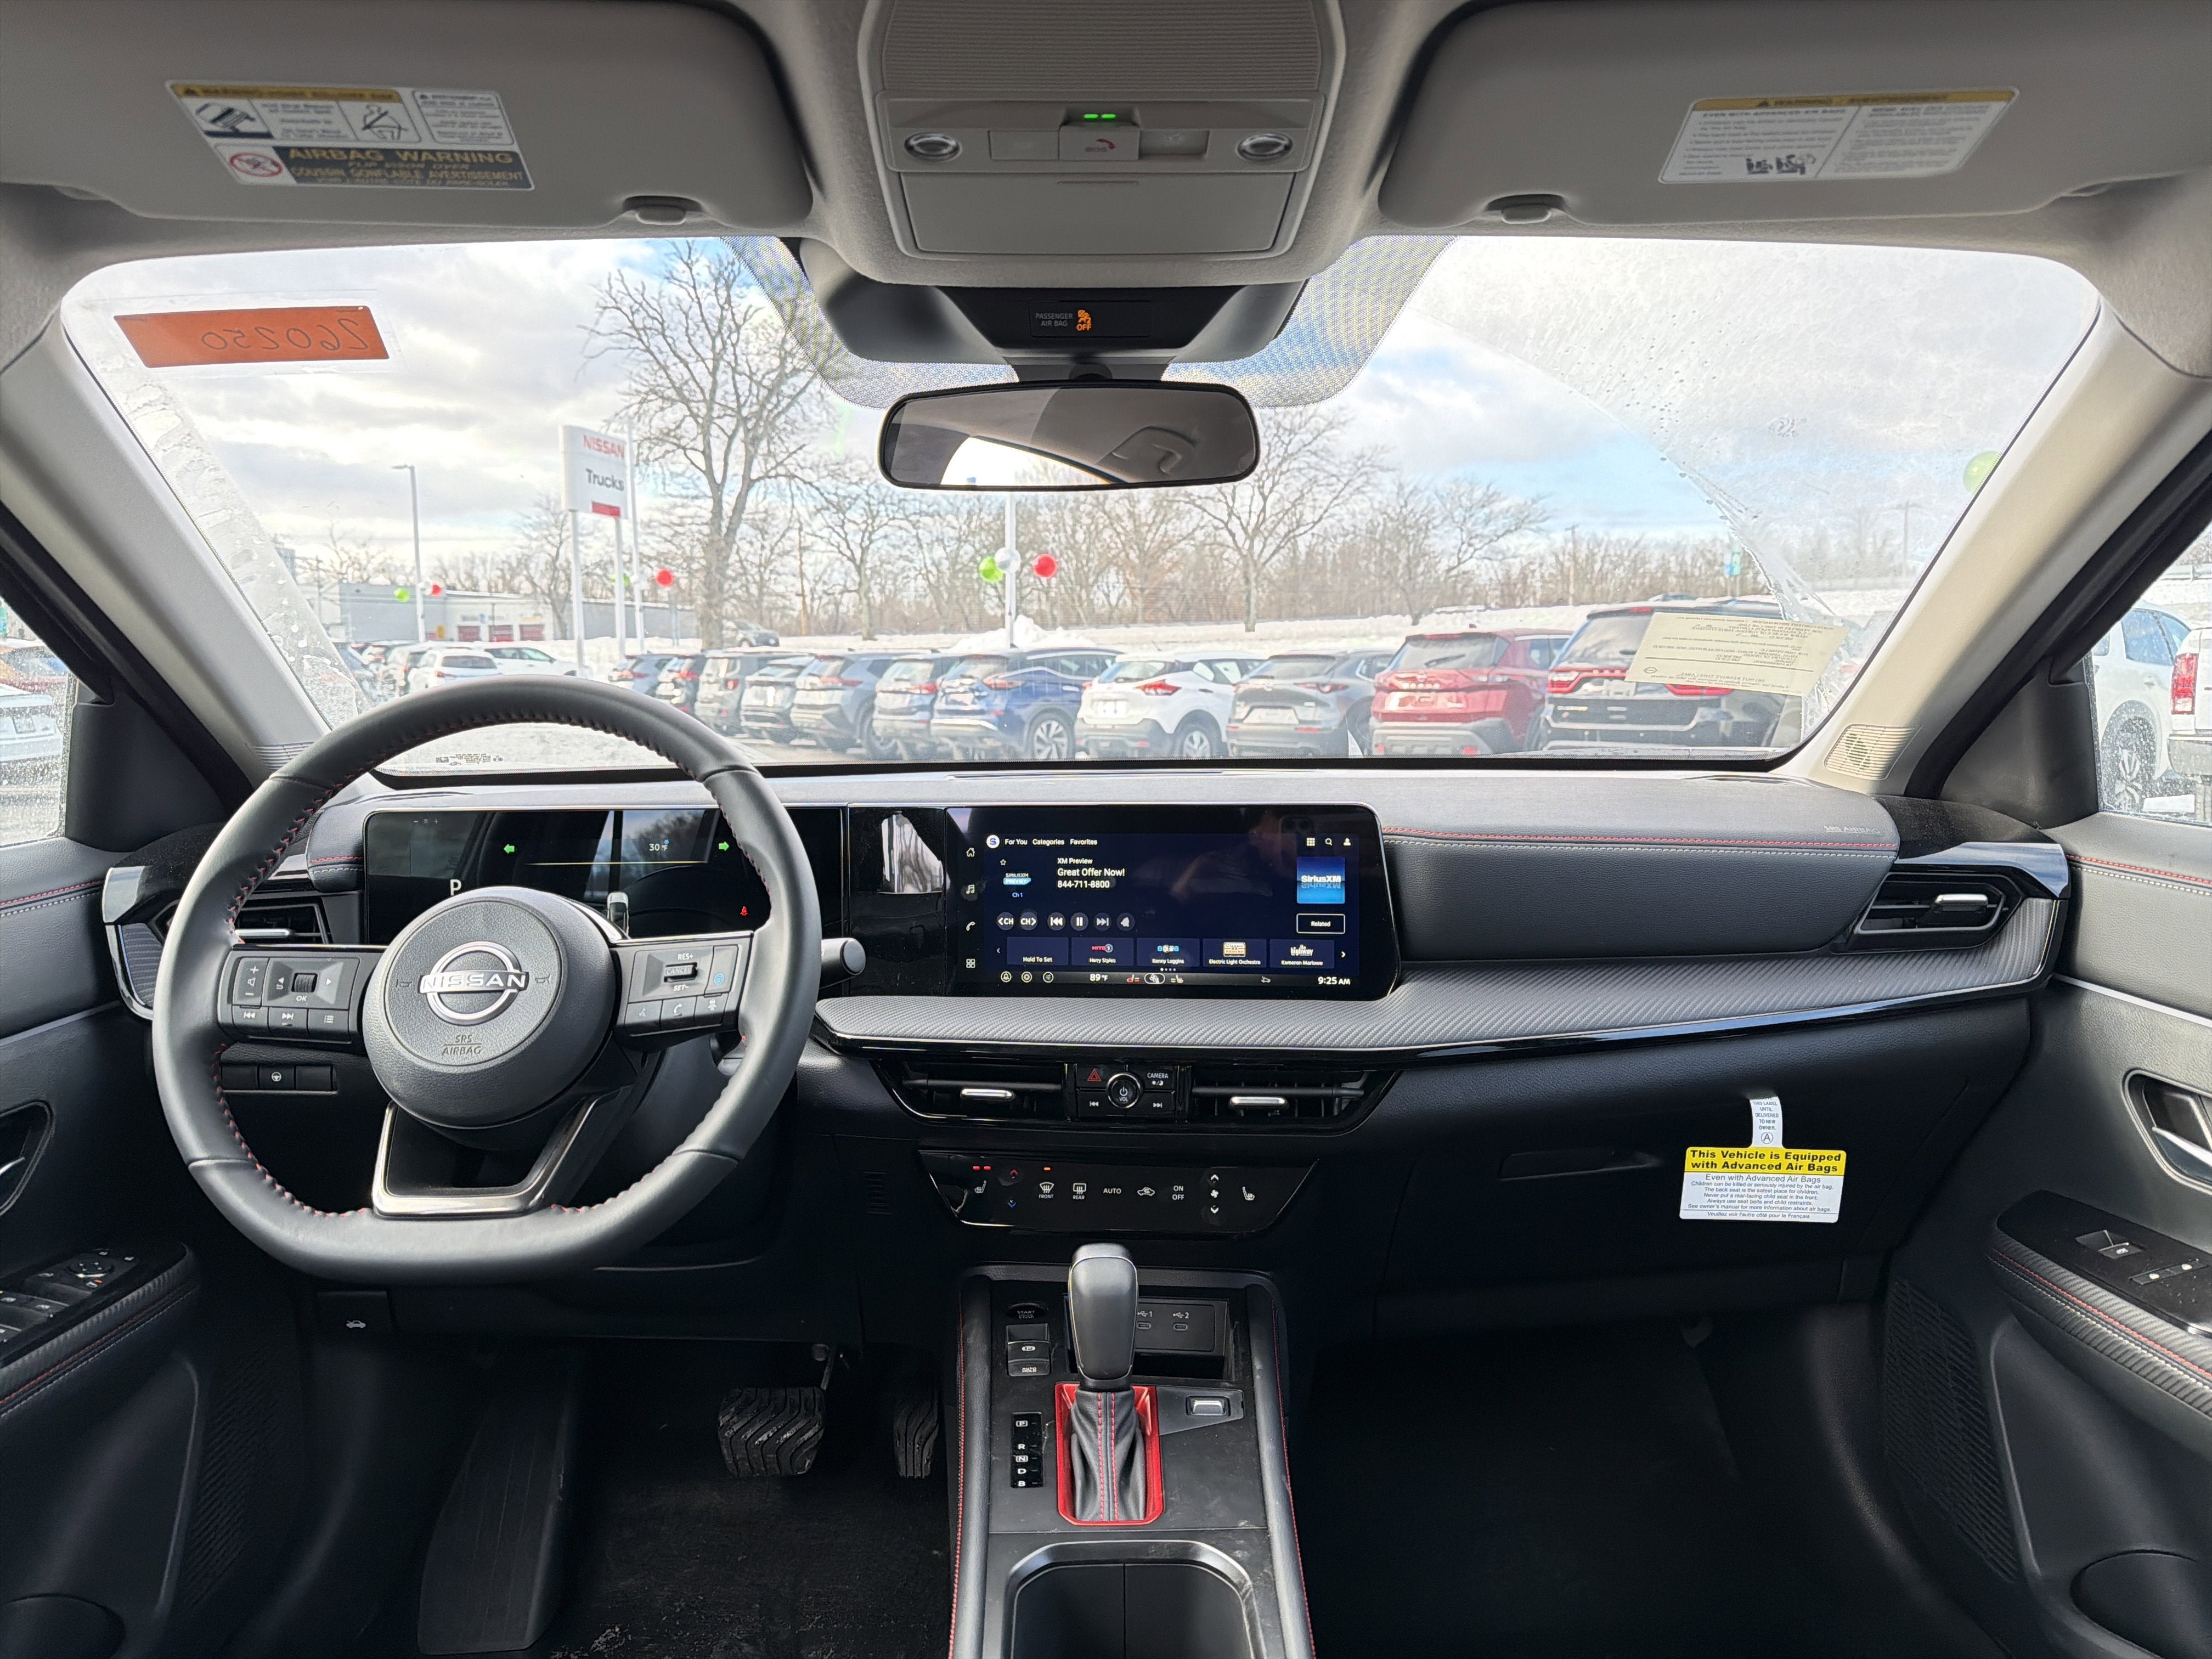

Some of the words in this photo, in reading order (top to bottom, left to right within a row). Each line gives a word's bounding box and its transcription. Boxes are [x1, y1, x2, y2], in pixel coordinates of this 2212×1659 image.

[289, 149, 383, 161] AIRBAG
[396, 150, 513, 163] WARNING
[583, 435, 625, 460] NISSAN
[586, 467, 625, 492] Trucks
[649, 843, 660, 851] 30
[1057, 868, 1080, 876] Great
[1081, 868, 1102, 876] Offer
[1104, 868, 1125, 877] Now!
[1301, 875, 1341, 883] SiriusXM
[450, 879, 462, 896] P
[1290, 947, 1313, 956] highway
[423, 974, 526, 989] NISSAN
[1318, 977, 1337, 985] 9:25
[455, 1035, 472, 1043] SRS
[442, 1046, 482, 1056] AIRBAG
[1690, 1150, 1716, 1158] This
[1720, 1150, 1765, 1159] Vehicle
[1770, 1151, 1780, 1159] is
[1784, 1152, 1841, 1162] Equipped
[1691, 1161, 1717, 1169] with
[1722, 1161, 1781, 1170] Advanced
[1786, 1163, 1803, 1171] Air
[1808, 1164, 1838, 1173] Bags
